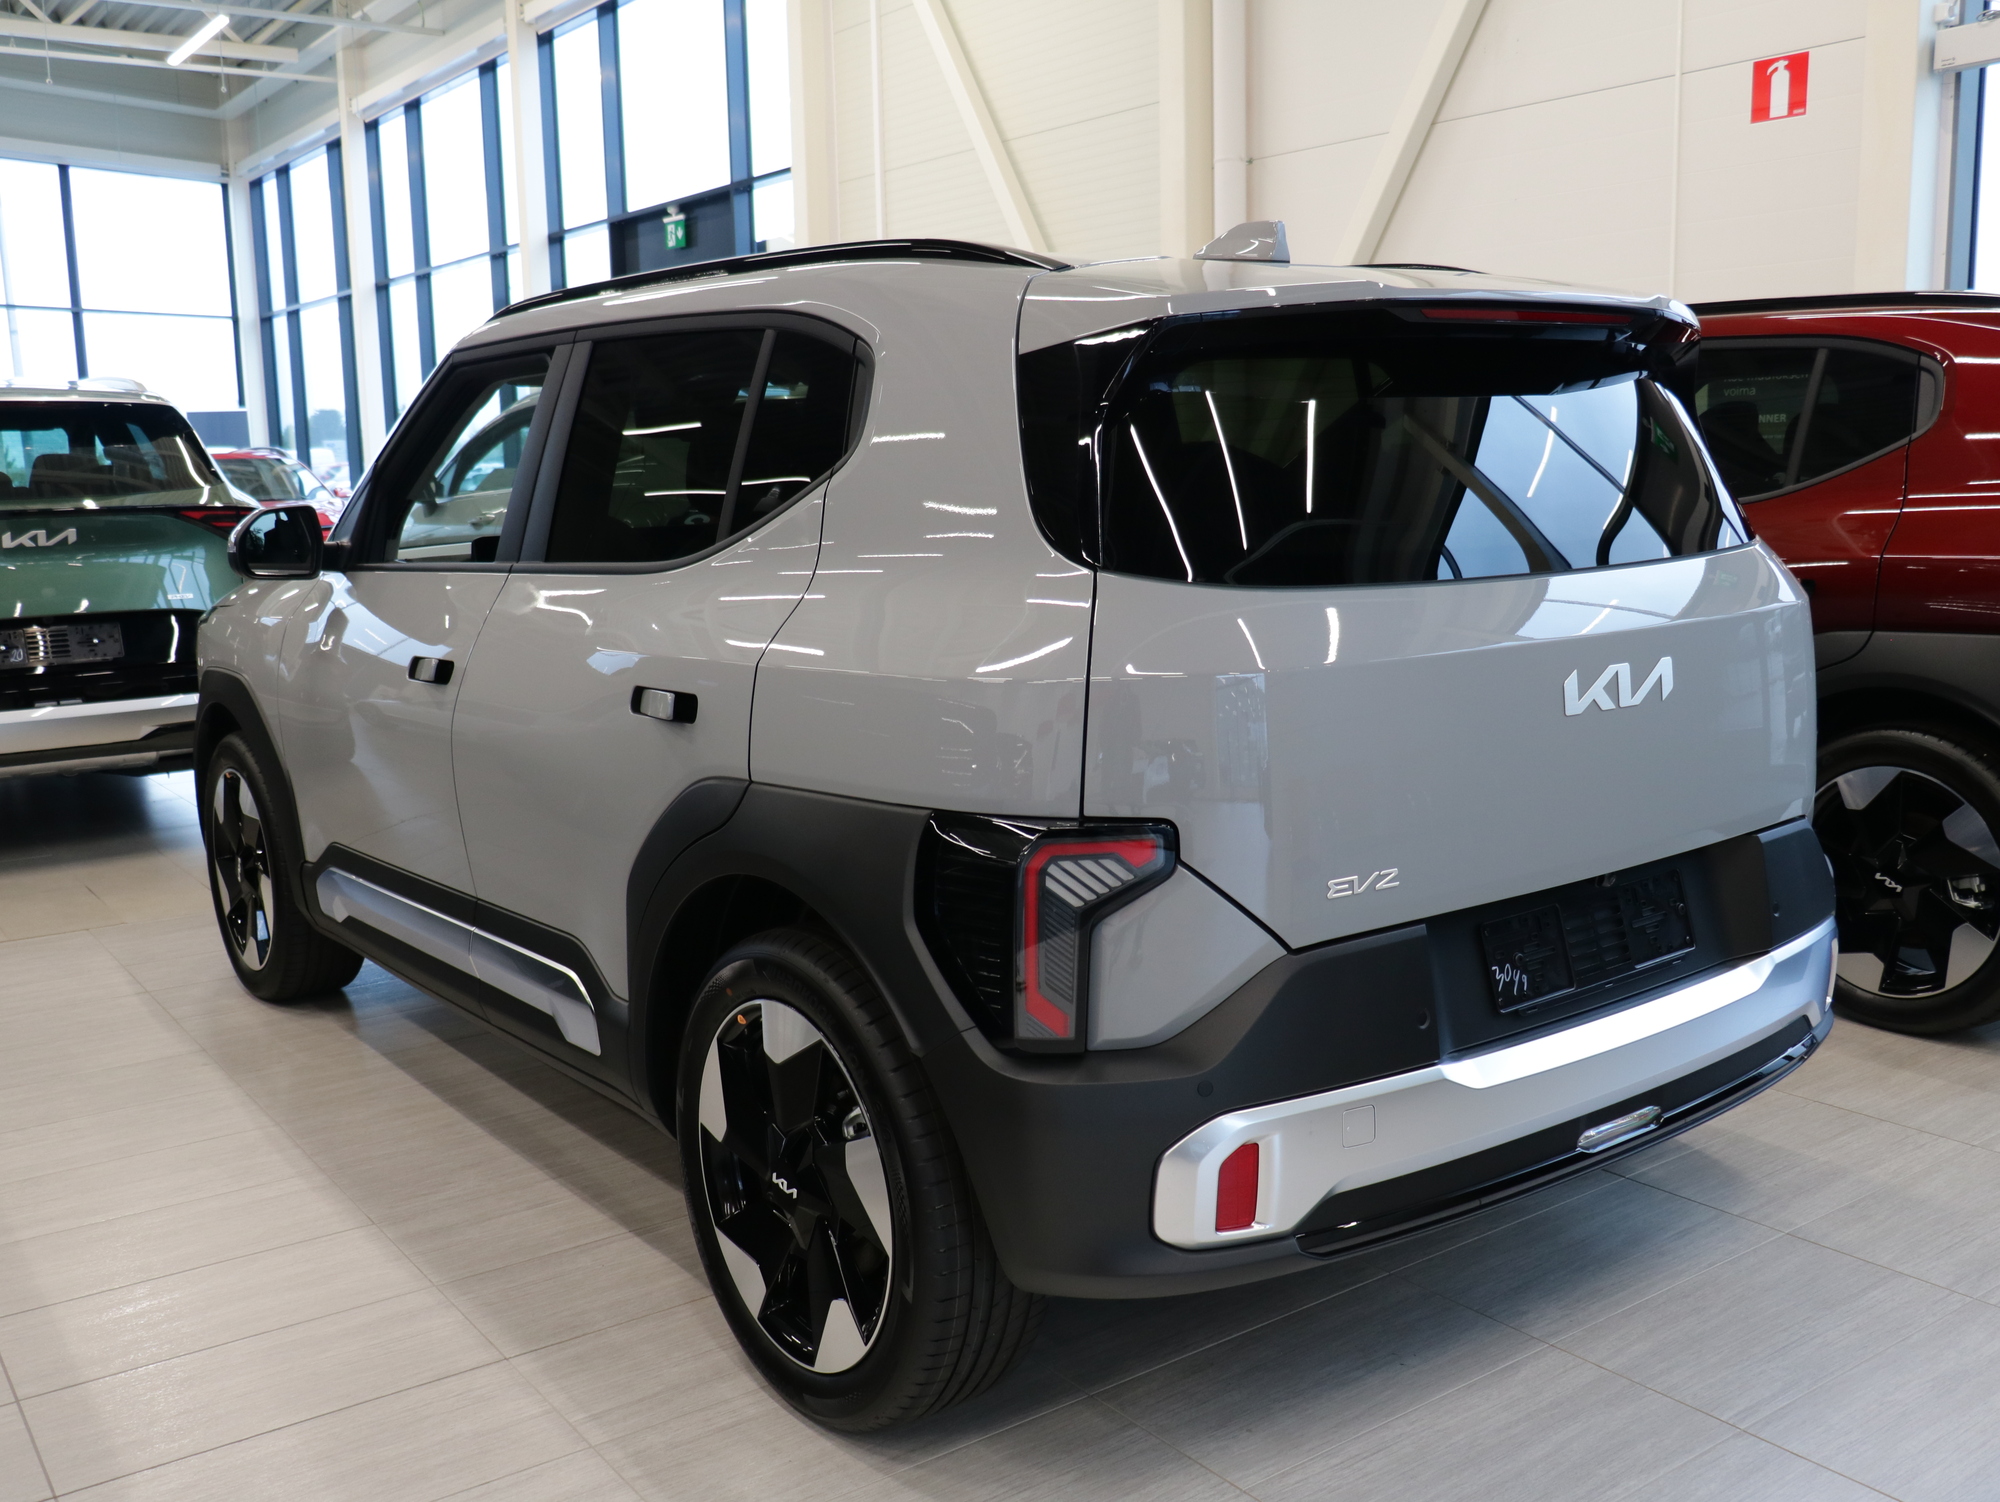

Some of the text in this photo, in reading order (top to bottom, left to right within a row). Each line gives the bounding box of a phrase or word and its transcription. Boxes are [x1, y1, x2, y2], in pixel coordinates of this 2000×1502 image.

[1723, 386, 1756, 397] voima
[2, 528, 77, 549] KIA
[1563, 656, 1674, 717] KIA
